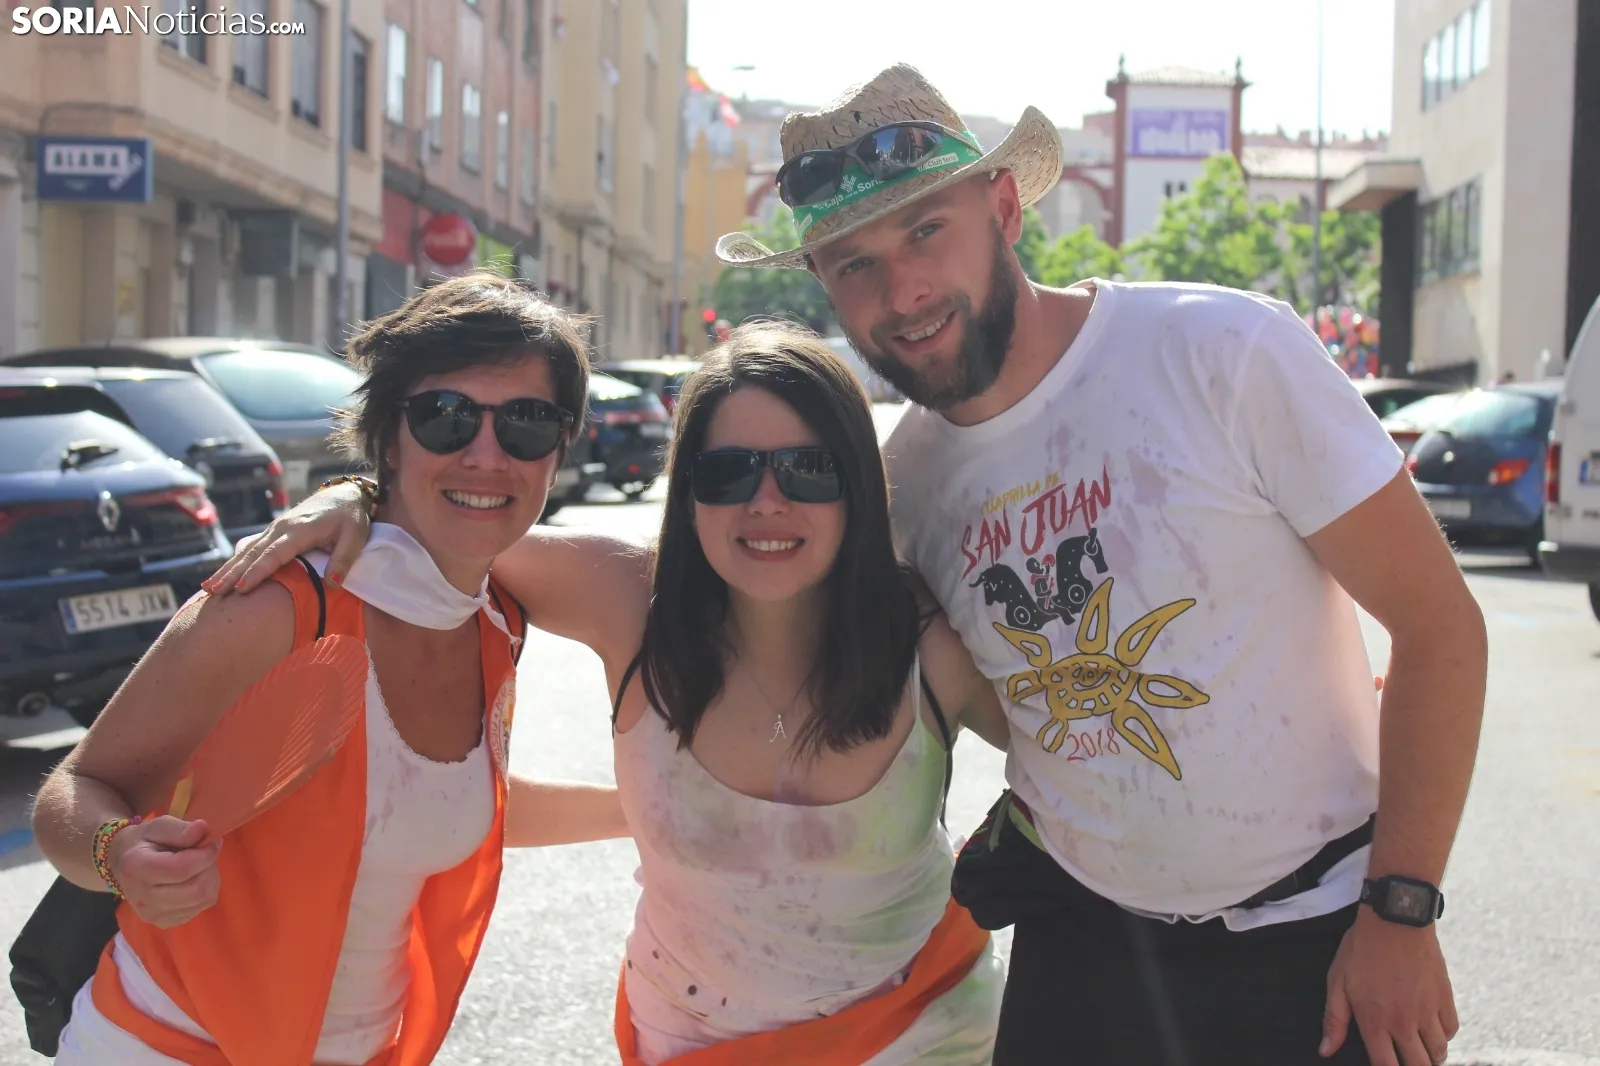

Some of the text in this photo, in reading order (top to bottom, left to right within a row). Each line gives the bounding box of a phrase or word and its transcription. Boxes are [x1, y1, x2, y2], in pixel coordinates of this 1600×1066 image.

[824, 193, 844, 209] Caja
[961, 464, 1111, 582] SAN JUAN
[1066, 727, 1120, 761] 2018
